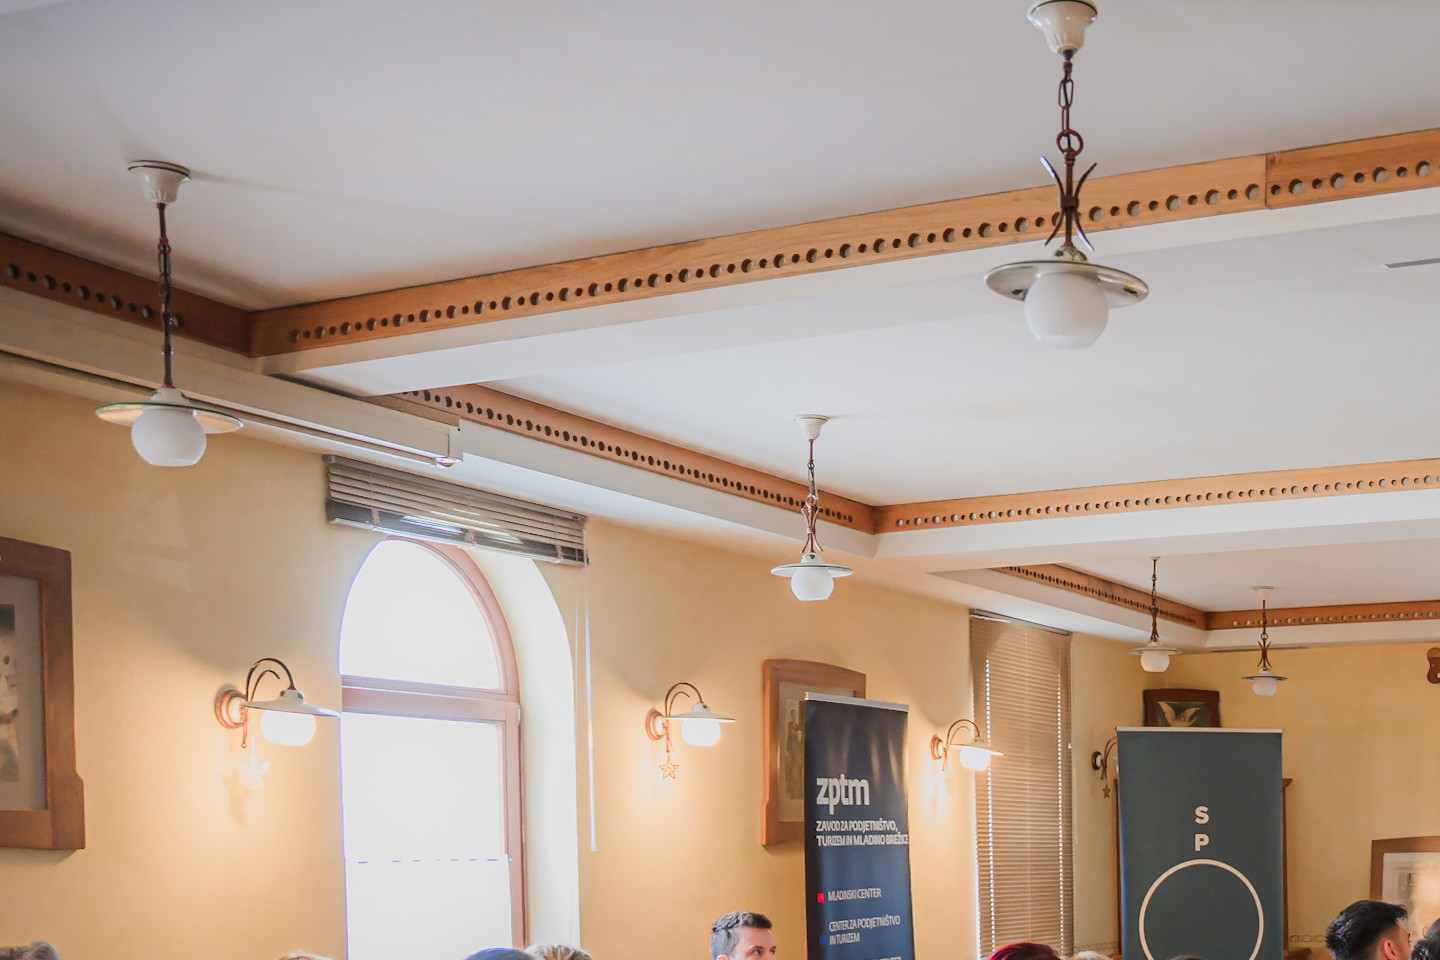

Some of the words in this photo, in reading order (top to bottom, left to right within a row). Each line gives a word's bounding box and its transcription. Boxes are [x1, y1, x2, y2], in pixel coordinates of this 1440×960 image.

[816, 774, 870, 815] zptm
[816, 821, 840, 832] ZAVOD
[841, 821, 849, 831] ZA
[849, 818, 898, 833] PODJETNIŠTVO,
[816, 835, 845, 847] TURIZEM
[845, 835, 853, 846] IN
[857, 888, 882, 899] CENTER
[829, 920, 849, 932] CENTER
[849, 919, 858, 930] ZA
[858, 914, 901, 930] PODJETNIŠTVO
[836, 932, 861, 944] TURIZEM
